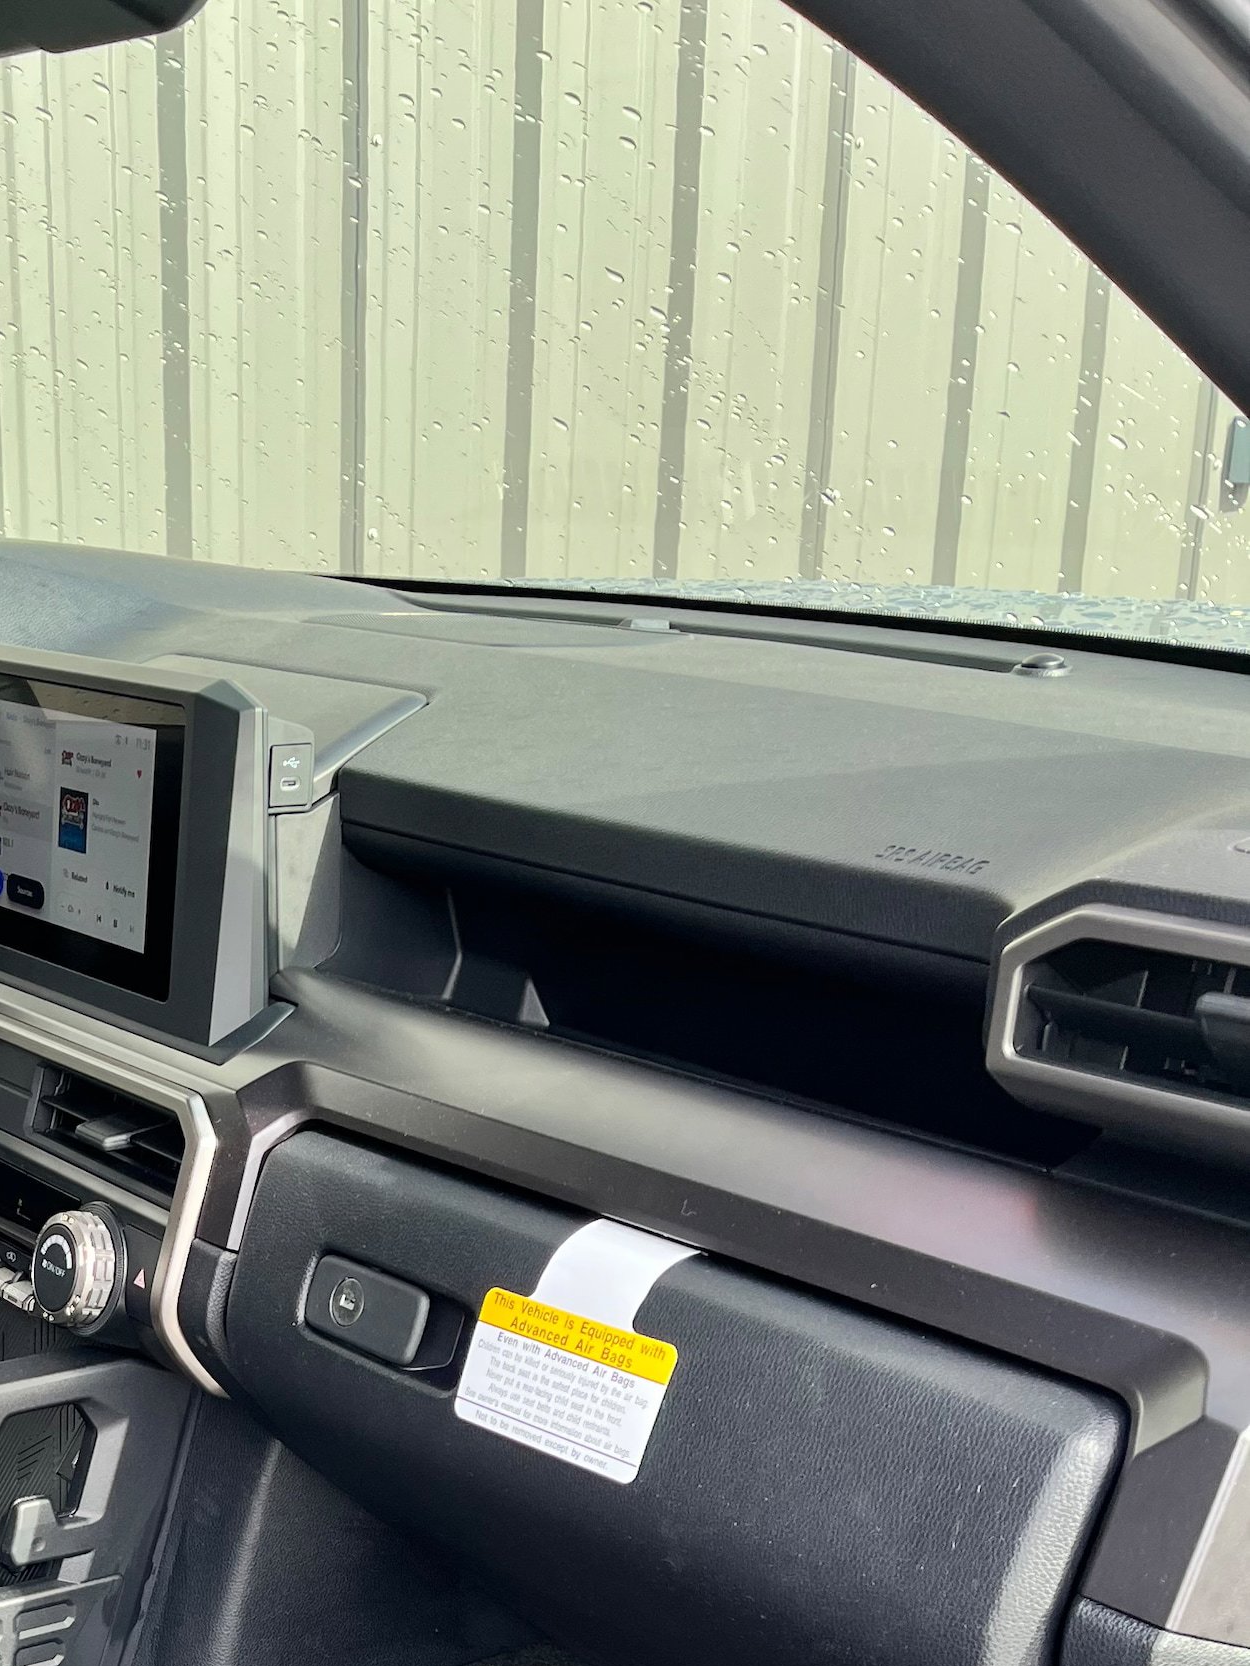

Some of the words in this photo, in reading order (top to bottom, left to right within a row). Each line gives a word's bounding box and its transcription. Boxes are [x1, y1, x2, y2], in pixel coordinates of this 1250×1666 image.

[493, 1291, 515, 1309] This
[520, 1300, 559, 1325] Vehicle
[565, 1315, 575, 1330] is
[580, 1320, 634, 1352] Equipped
[640, 1340, 666, 1360] with
[511, 1316, 568, 1346] Advanced
[575, 1338, 593, 1355] Air
[600, 1346, 633, 1370] Bags
[498, 1331, 518, 1346] Even
[522, 1340, 540, 1354] with
[544, 1348, 588, 1372] Advanced
[593, 1365, 606, 1378] Air
[610, 1371, 635, 1391] Bags
[475, 1409, 487, 1422] Not
[489, 1415, 497, 1425] to
[499, 1419, 509, 1430] be
[512, 1425, 541, 1443] removed
[544, 1438, 567, 1455] except
[570, 1448, 580, 1460] by
